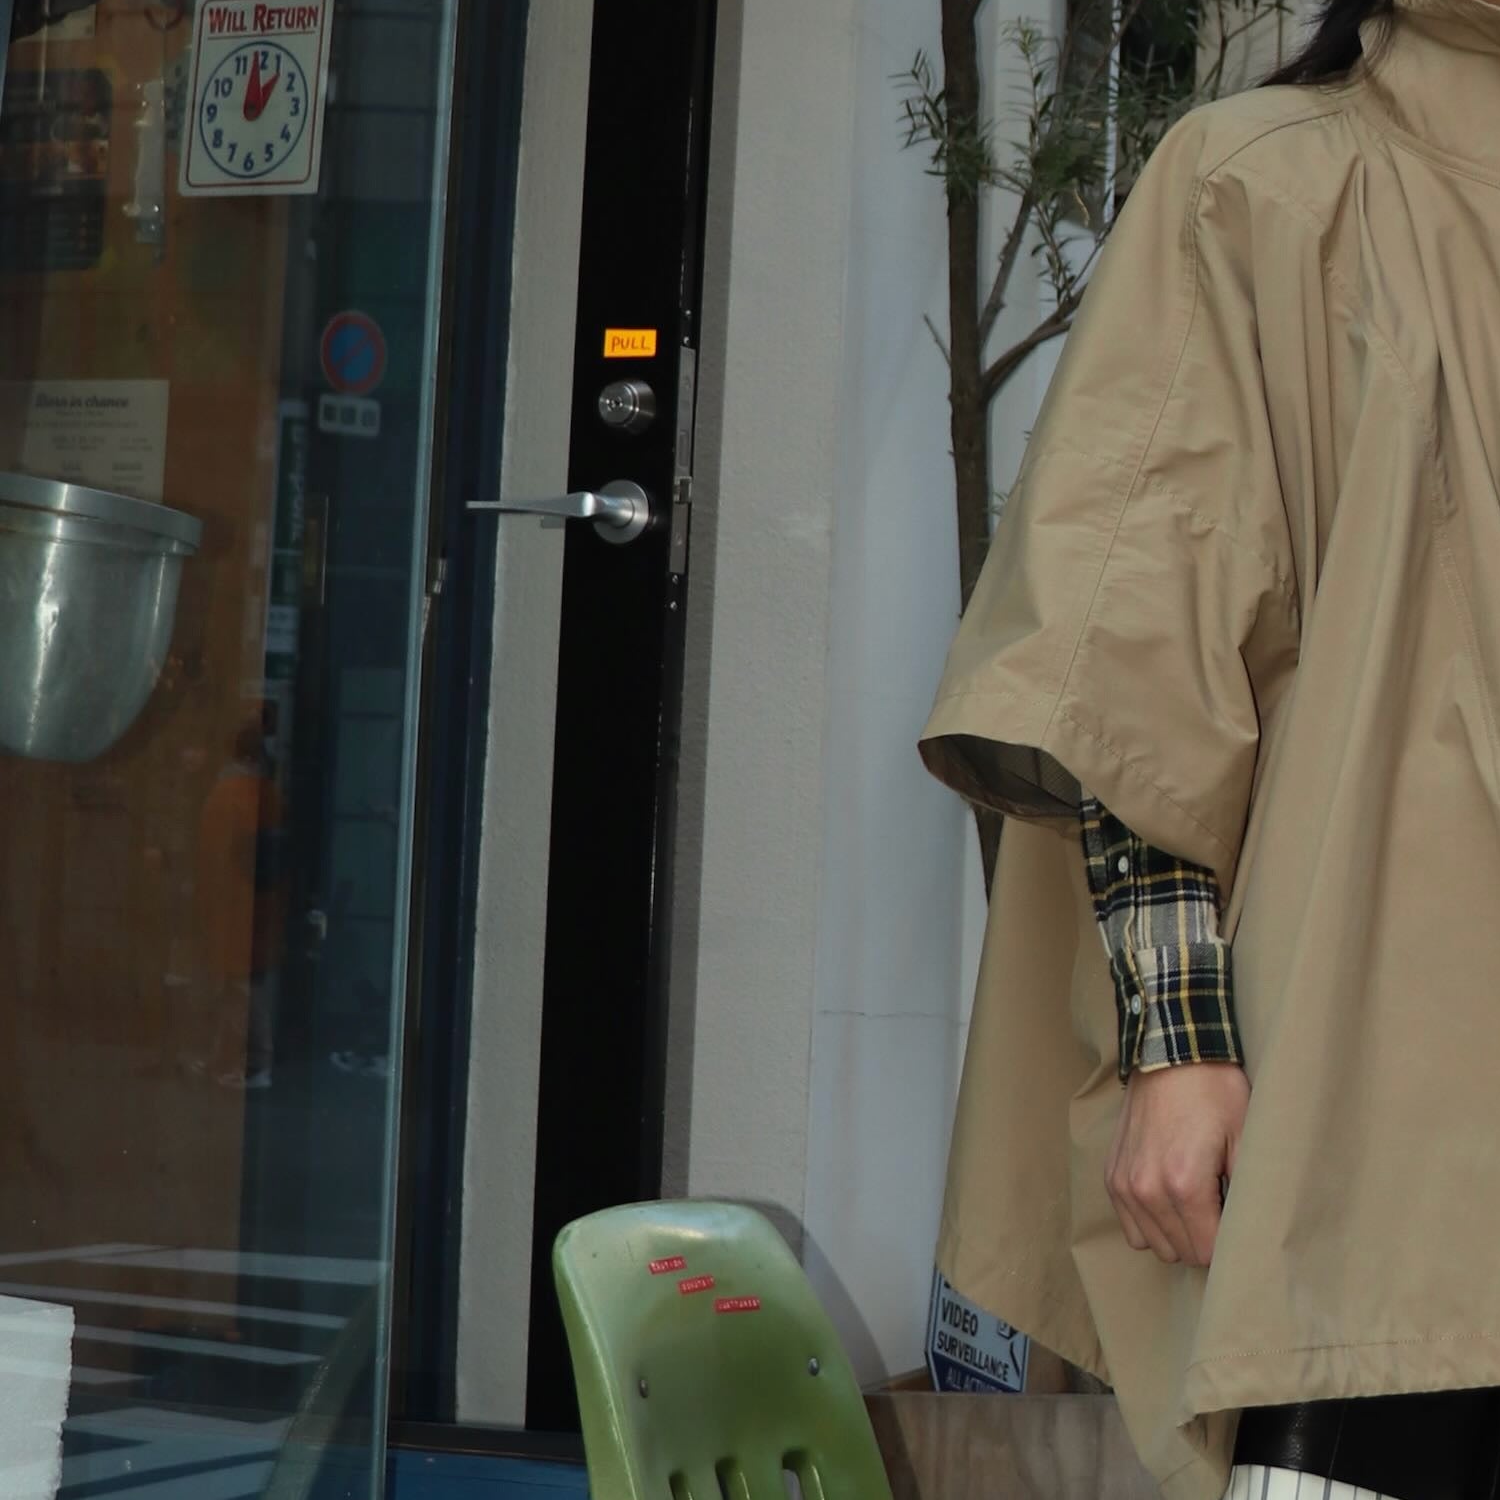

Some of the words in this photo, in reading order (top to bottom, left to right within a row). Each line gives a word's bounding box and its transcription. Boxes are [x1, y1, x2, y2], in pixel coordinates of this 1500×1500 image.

[208, 7, 247, 34] WILL
[252, 3, 319, 33] RETURN
[235, 54, 248, 76] 11
[214, 77, 233, 98] 10
[286, 72, 295, 92] 2
[206, 103, 217, 123] 9
[290, 97, 300, 116] 3
[212, 128, 223, 149] 8
[280, 123, 290, 143] 4
[228, 143, 238, 162] 7
[243, 151, 254, 172] 6
[264, 143, 274, 162] 5
[611, 335, 651, 353] PULL
[941, 1297, 978, 1337] VIDEO
[936, 1331, 1009, 1383] SURVEILLANCE
